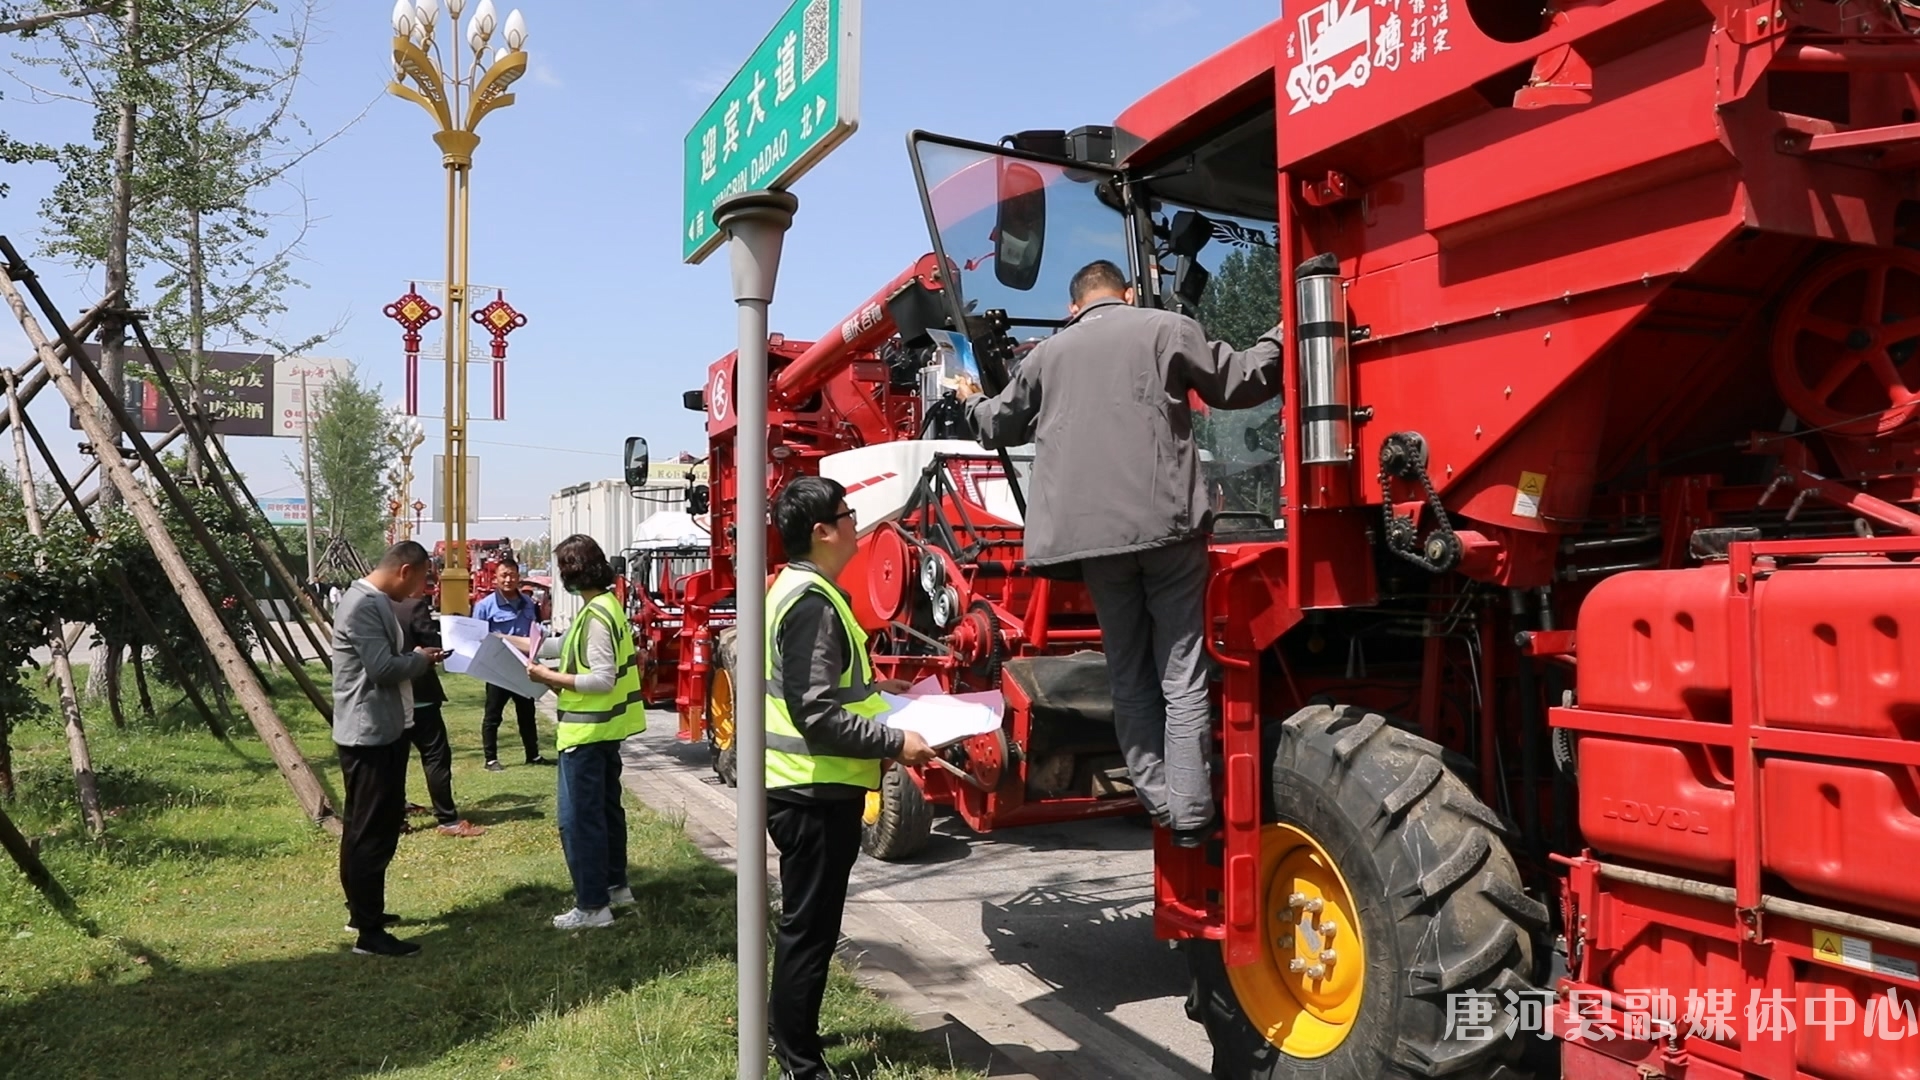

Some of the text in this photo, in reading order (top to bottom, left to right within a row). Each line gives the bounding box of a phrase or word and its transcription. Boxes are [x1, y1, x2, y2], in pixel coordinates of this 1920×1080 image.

[701, 29, 798, 185] 迎宾大道
[751, 128, 788, 185] DADAO
[800, 103, 813, 140] 北
[1602, 796, 1709, 835] LOVOL
